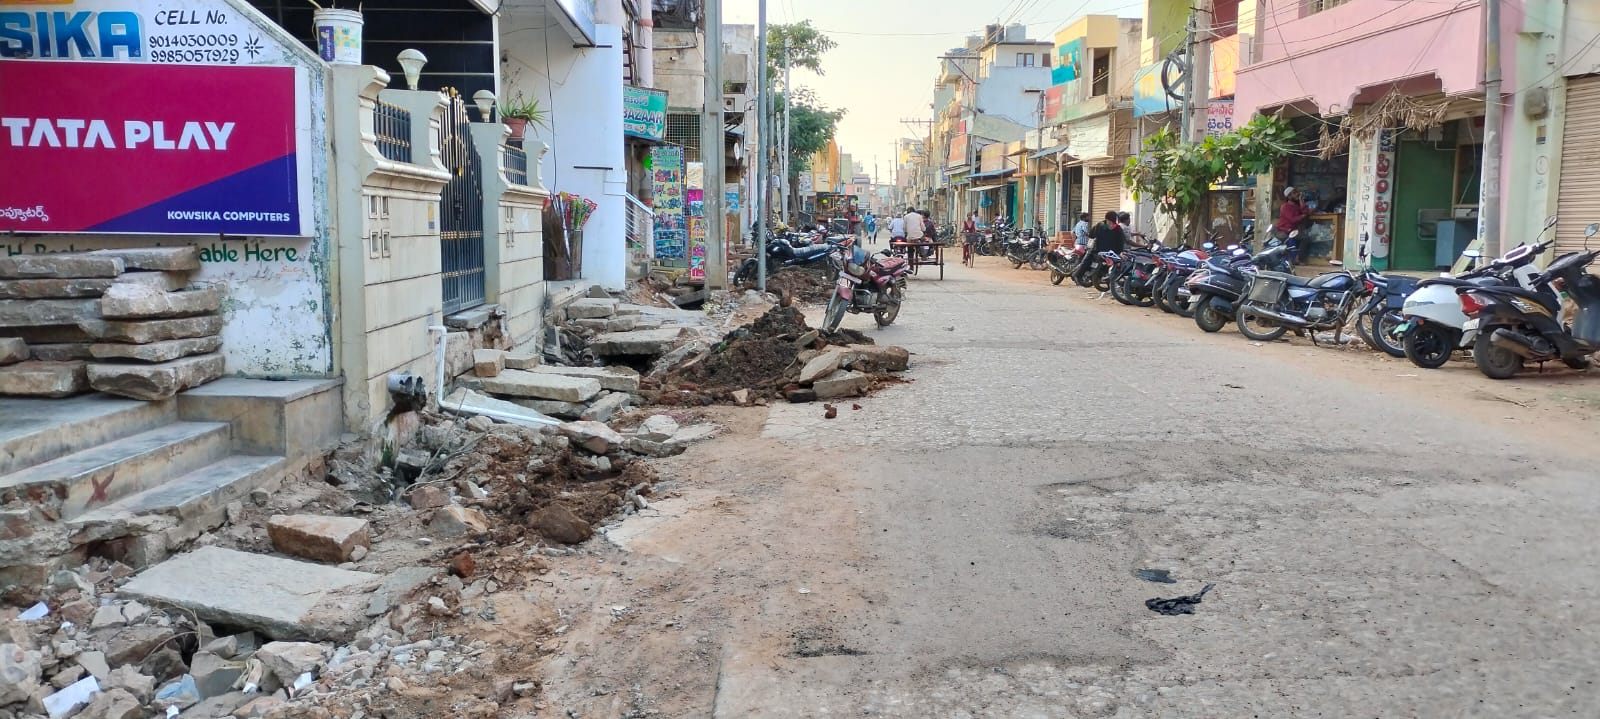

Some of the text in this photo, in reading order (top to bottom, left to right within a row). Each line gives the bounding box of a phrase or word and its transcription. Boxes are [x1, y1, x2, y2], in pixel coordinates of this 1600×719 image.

[154, 9, 228, 26] CELL No.
[149, 34, 238, 48] 9014030009
[151, 48, 240, 64] 9985057929
[1, 117, 236, 151] TATA PLAY
[167, 210, 290, 222] KOWSIKA COMPUTERS
[244, 242, 298, 262] Here
